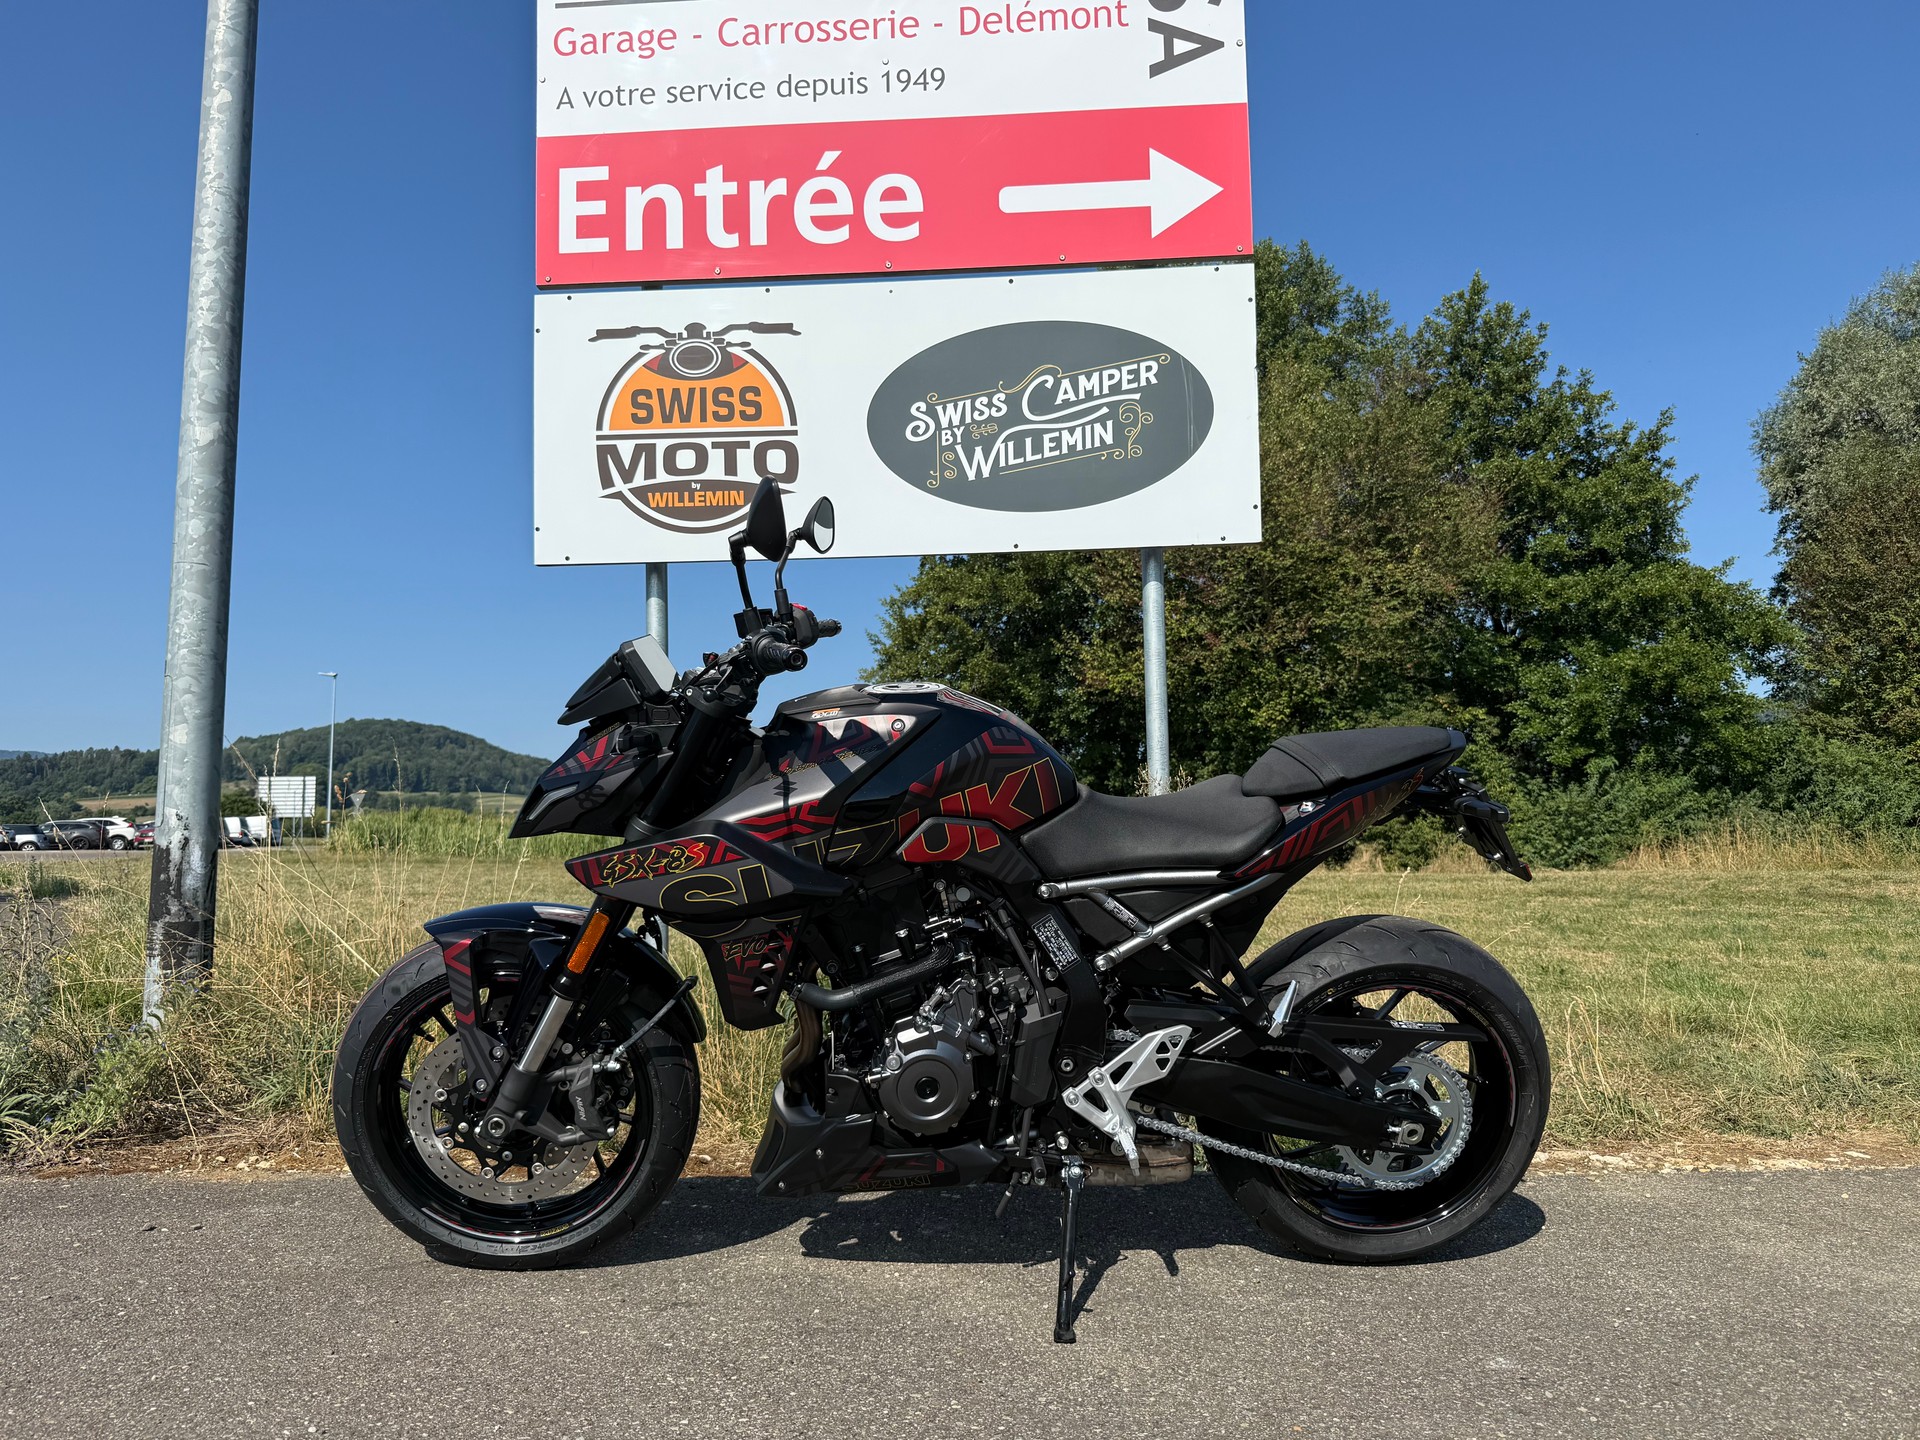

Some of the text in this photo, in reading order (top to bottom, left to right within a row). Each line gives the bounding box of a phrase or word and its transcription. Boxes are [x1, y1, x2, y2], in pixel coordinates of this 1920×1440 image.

[553, 26, 678, 60] Garage
[717, 9, 920, 48] Carrosserie
[959, 0, 1130, 37] Delémont
[556, 67, 946, 110] A votre service depuis 1949
[558, 150, 926, 254] Entrée
[630, 386, 762, 425] SWISS
[905, 360, 1159, 442] SWISS CAMPER
[598, 439, 800, 492] MOTO
[941, 407, 1114, 482] BY WILLEMIN
[647, 490, 745, 509] WILLEMIN
[691, 481, 702, 490] by
[599, 841, 706, 889] GSX-8S
